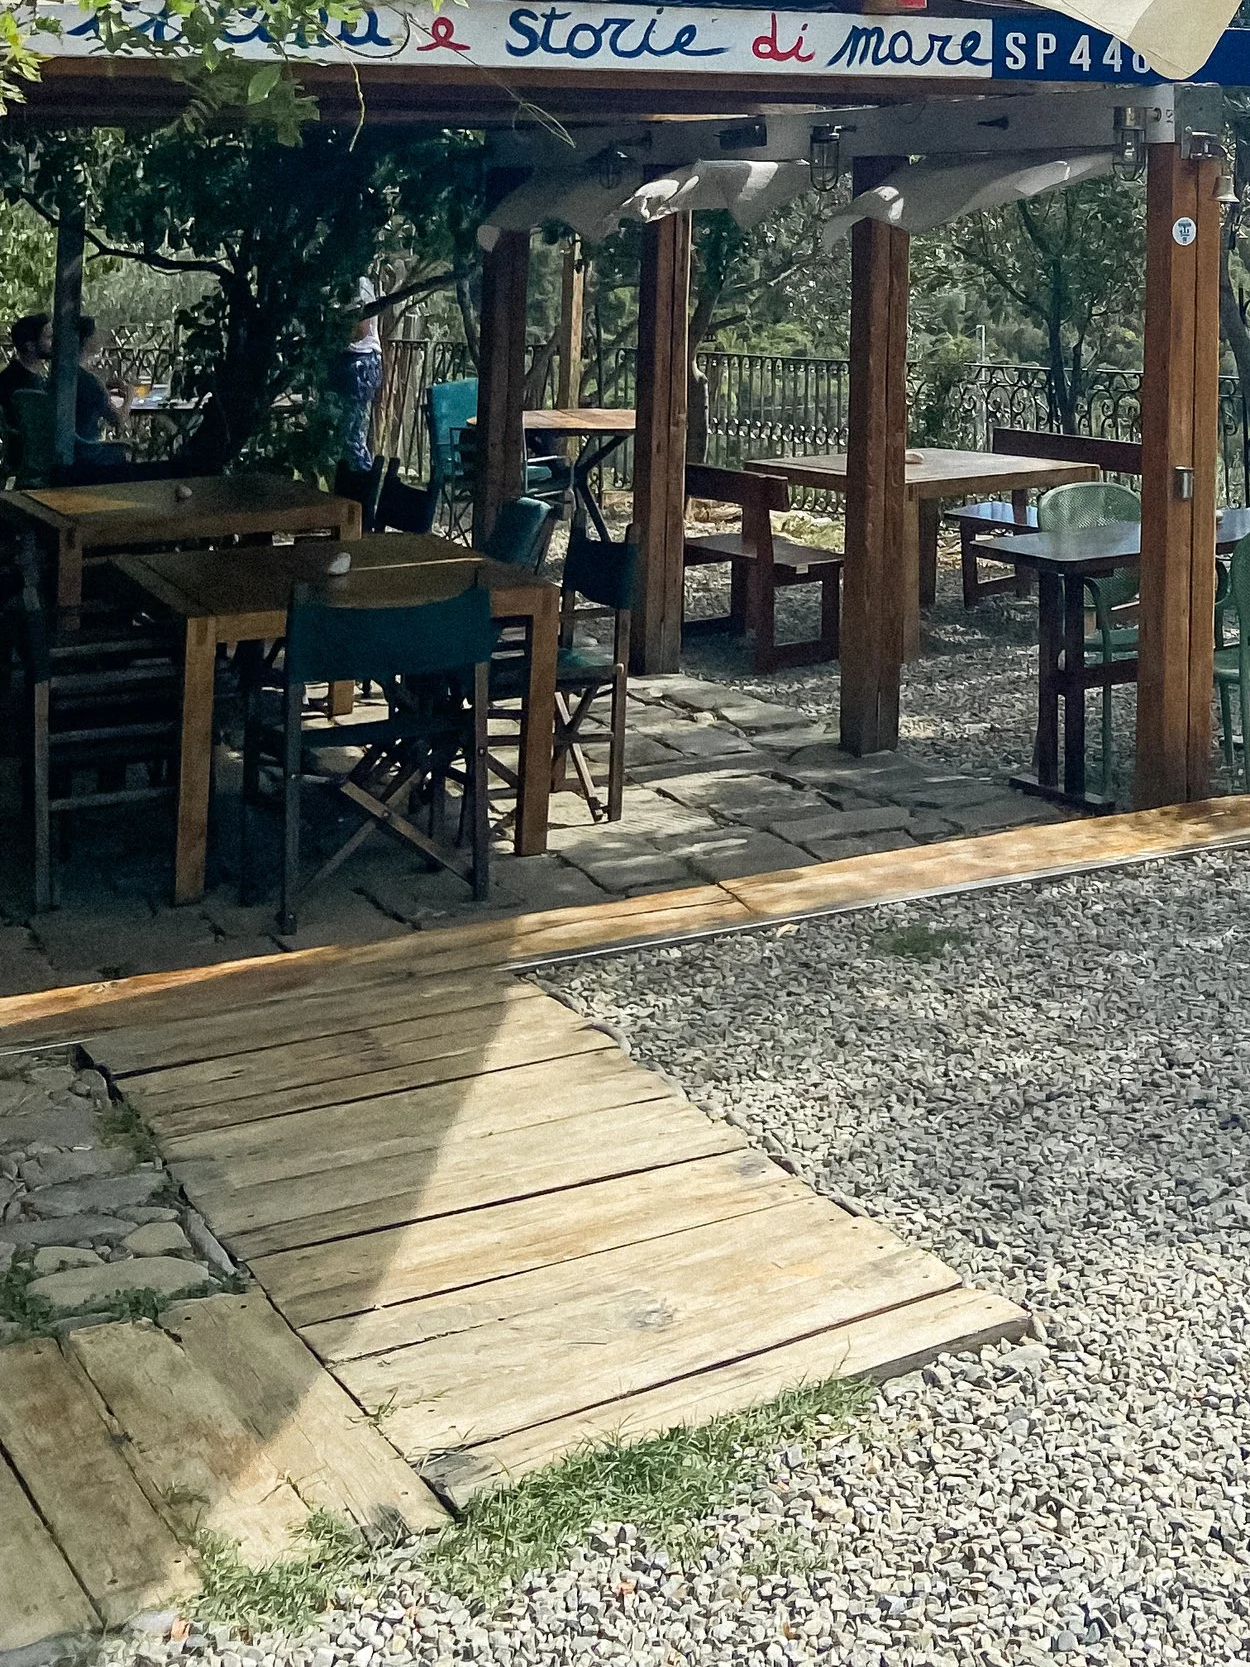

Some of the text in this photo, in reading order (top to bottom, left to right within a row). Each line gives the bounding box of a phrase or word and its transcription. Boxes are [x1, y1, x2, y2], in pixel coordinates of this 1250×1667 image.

[417, 16, 471, 51] e
[752, 12, 816, 63] di
[824, 24, 993, 68] mare
[1005, 32, 1057, 71] SP
